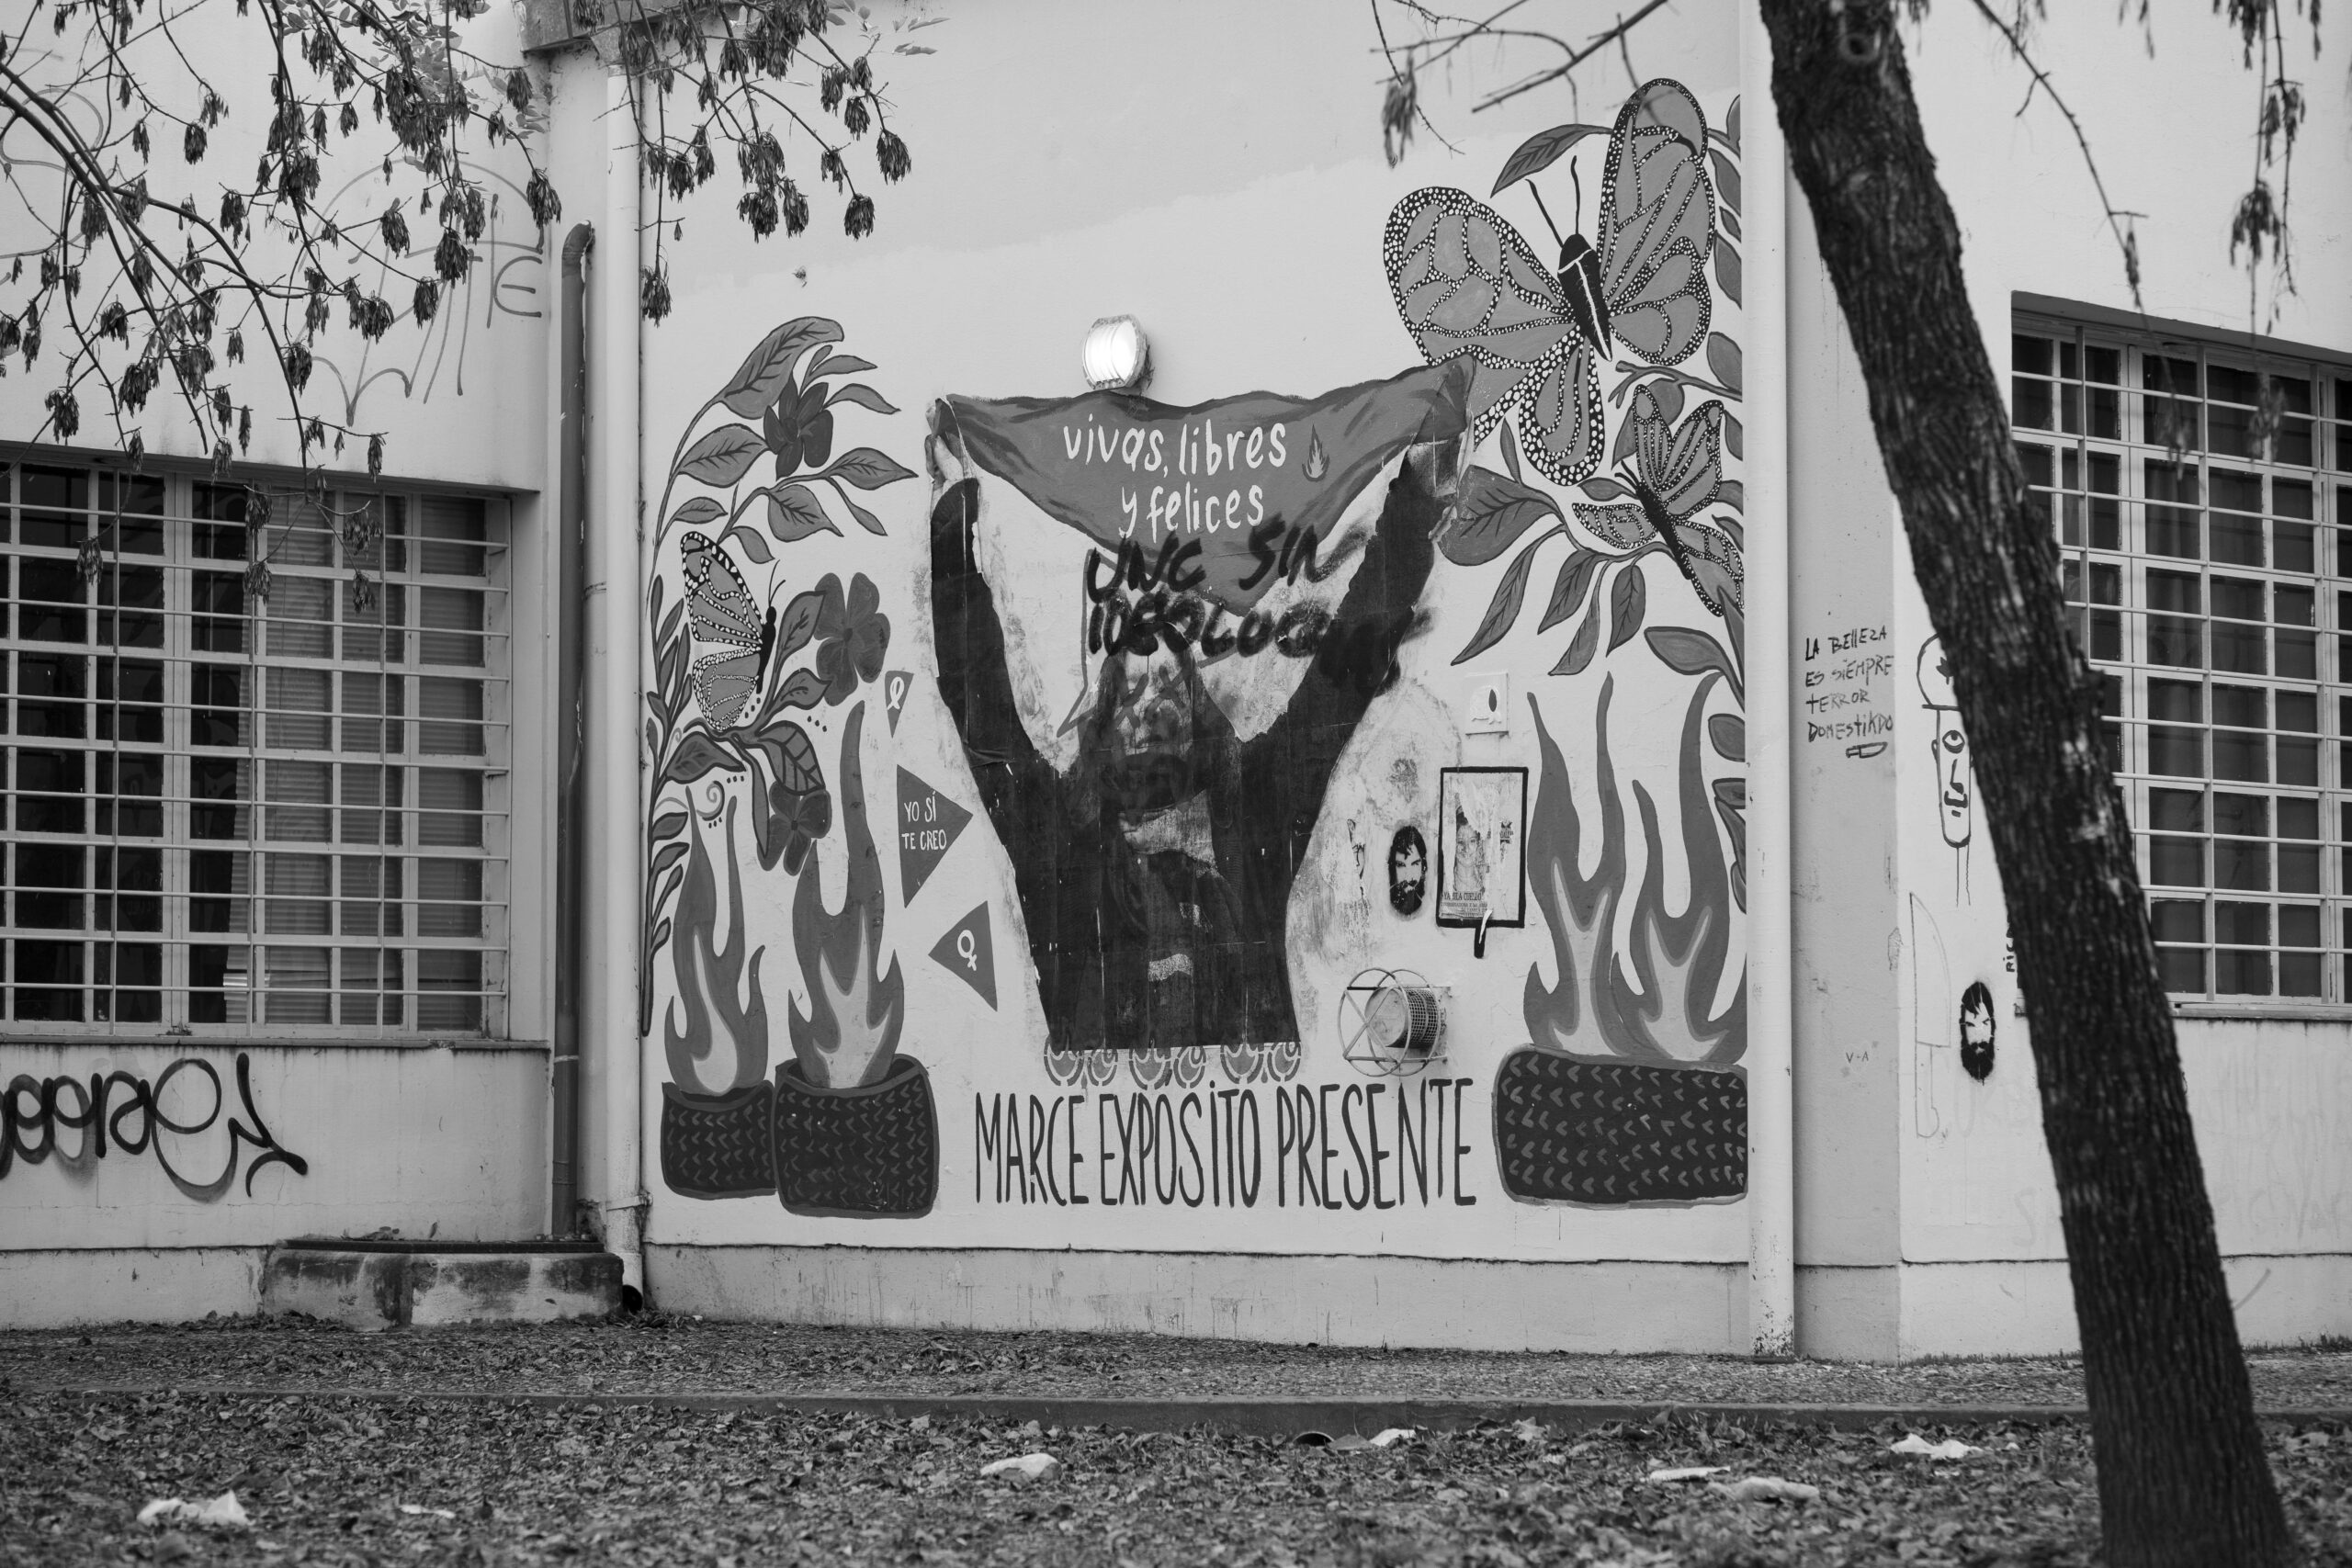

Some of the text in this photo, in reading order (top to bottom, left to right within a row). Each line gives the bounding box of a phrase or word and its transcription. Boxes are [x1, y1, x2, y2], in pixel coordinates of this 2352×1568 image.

[1063, 413, 1286, 478] vivas, libres
[1118, 481, 1264, 542] y felices
[1088, 513, 1369, 604] UNC SIN
[1804, 637, 1820, 661] LA
[1805, 671, 1825, 687] ES
[903, 790, 937, 822] YO SÍ
[901, 829, 947, 851] TE CREO
[976, 1091, 1090, 1207] MARCE
[1276, 1077, 1477, 1210] PRESENTE
